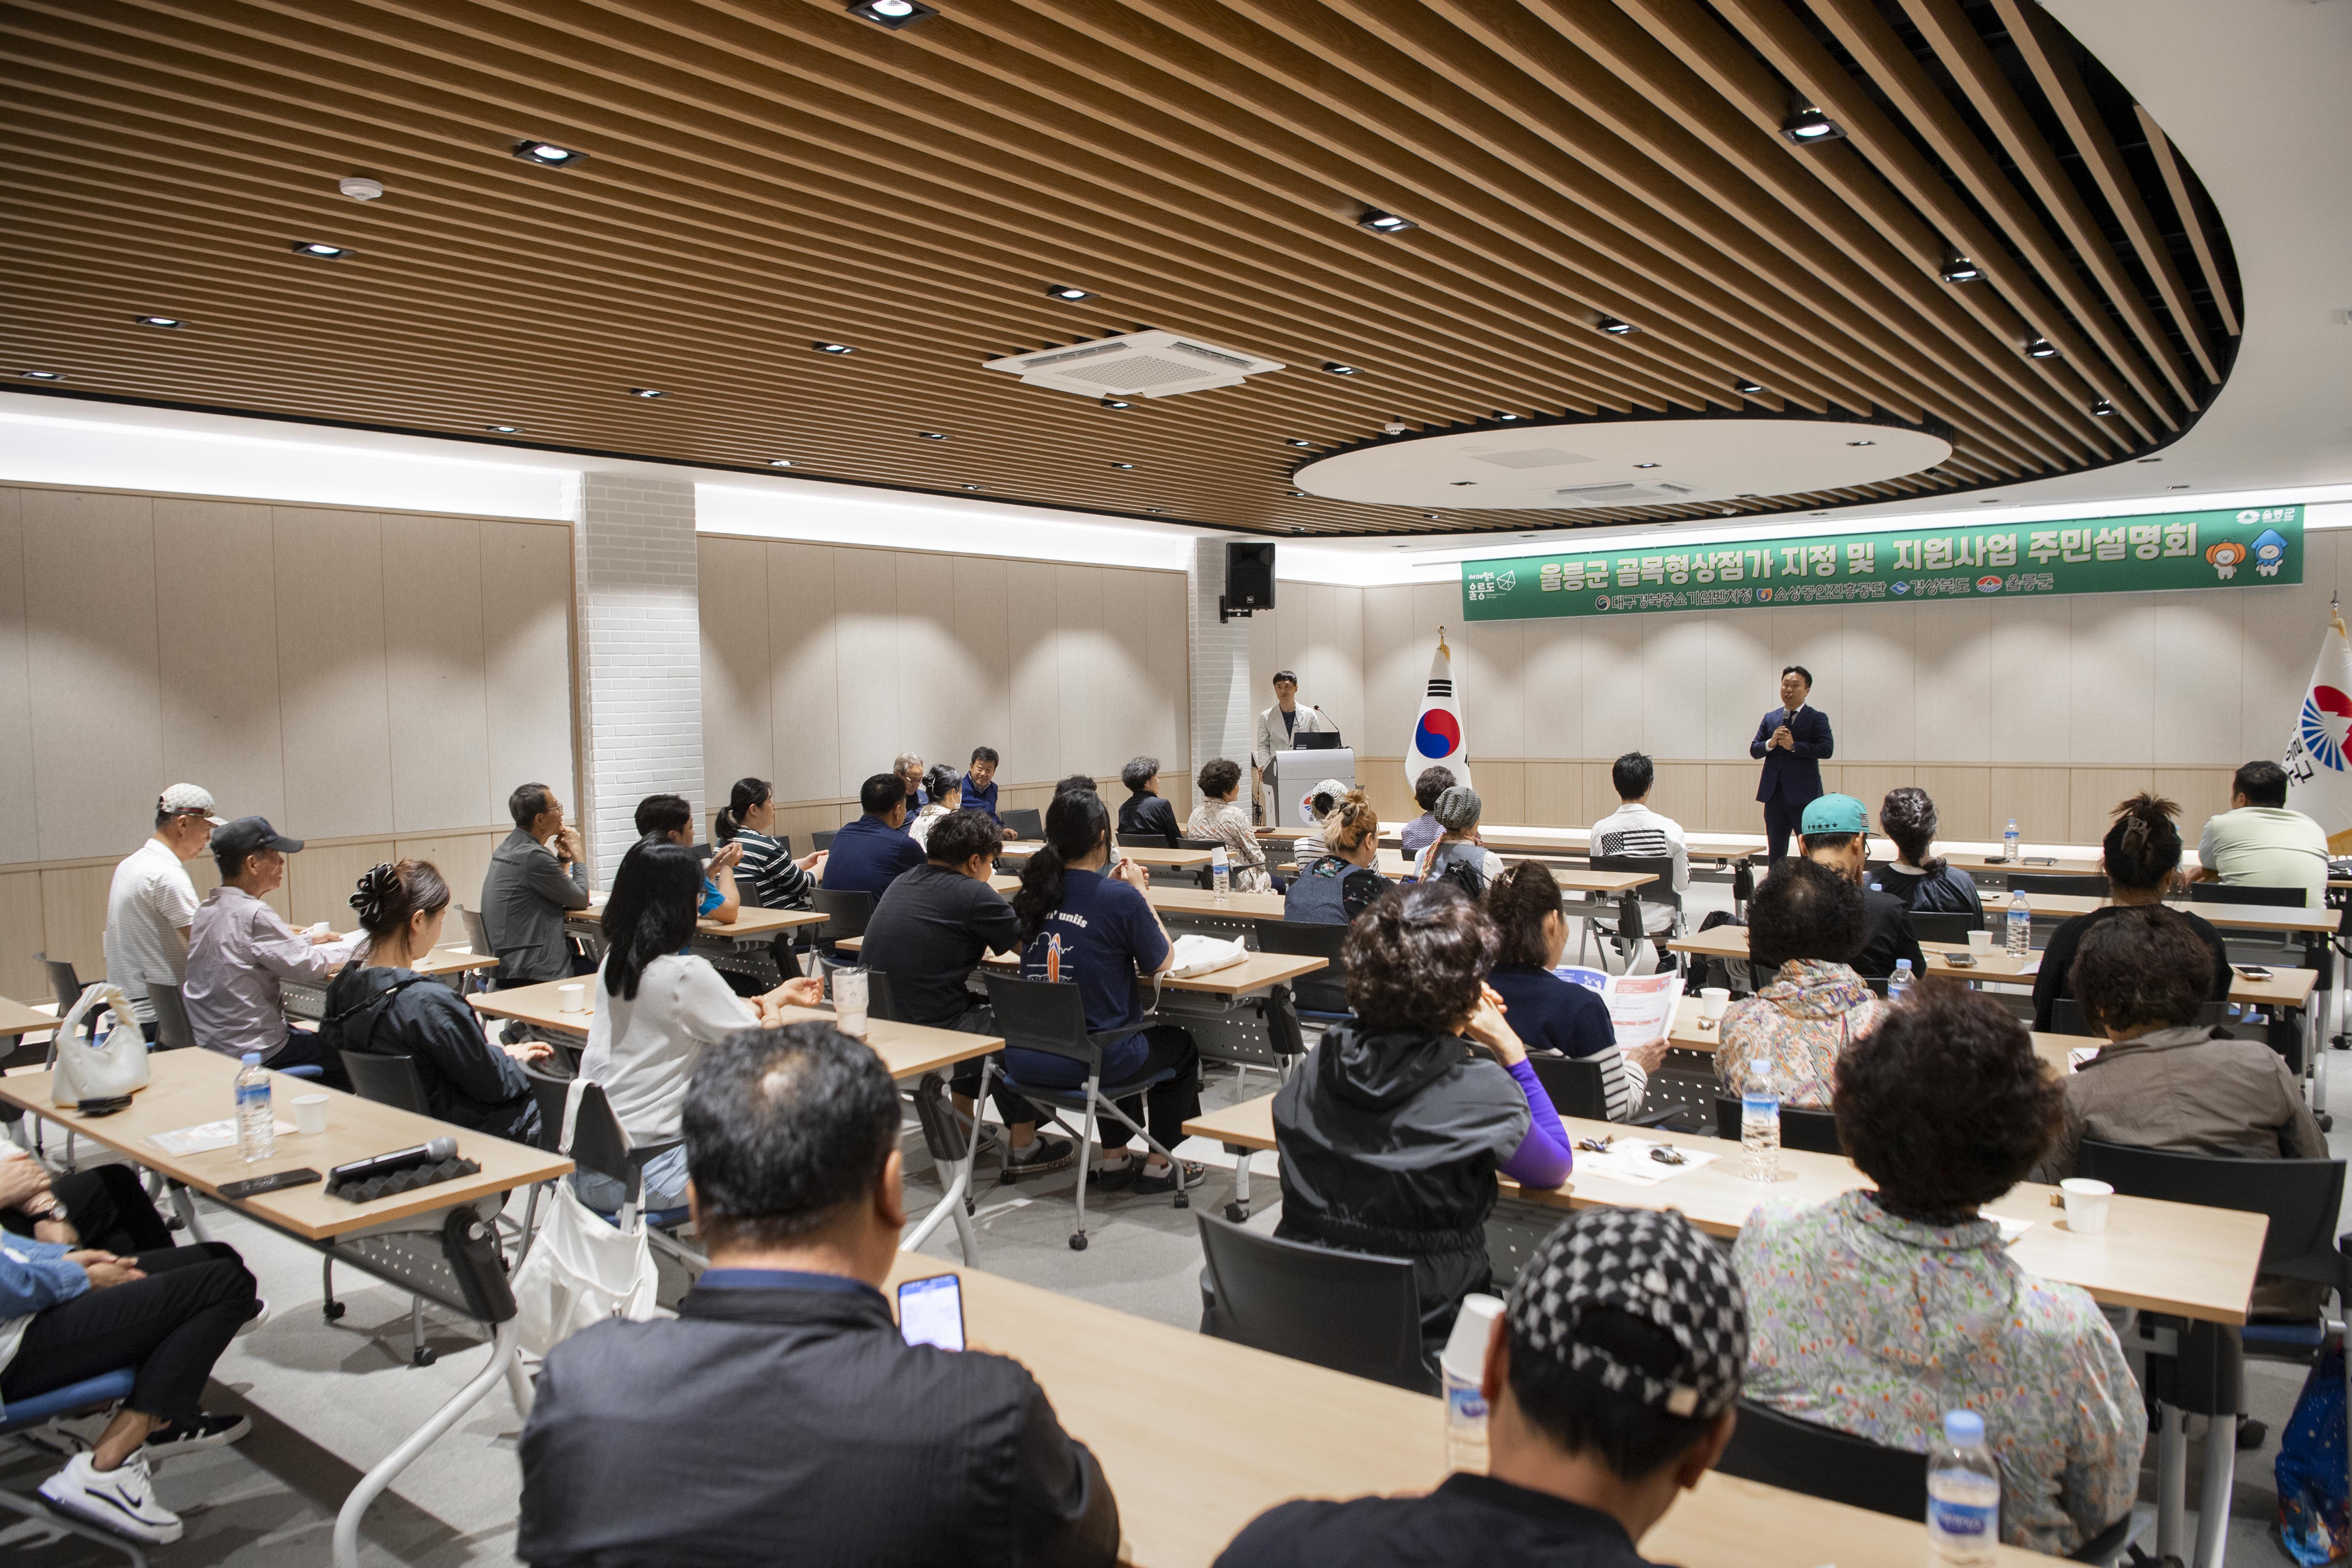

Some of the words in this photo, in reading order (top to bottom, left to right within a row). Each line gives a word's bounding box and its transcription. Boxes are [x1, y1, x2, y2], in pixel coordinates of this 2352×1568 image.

[1540, 561, 1609, 591] 울릉군
[1617, 549, 1774, 587] 골목형상점가
[1781, 545, 1836, 577] 지정
[1847, 542, 1874, 574] 및
[1893, 533, 2017, 570] 지원사업
[2029, 523, 2197, 564] 주민설명회
[1468, 572, 1494, 581] 에메랄드
[1468, 583, 1494, 600] 울릉도
[1612, 588, 1752, 609] 대구경북중소기업벤처청
[1774, 581, 1887, 602] 소상공인진흥공단
[1910, 577, 1970, 596] 경상북도
[2006, 573, 2053, 591] 울릉군
[2286, 721, 2315, 787] 릉군
[1059, 912, 1088, 928] uniis
